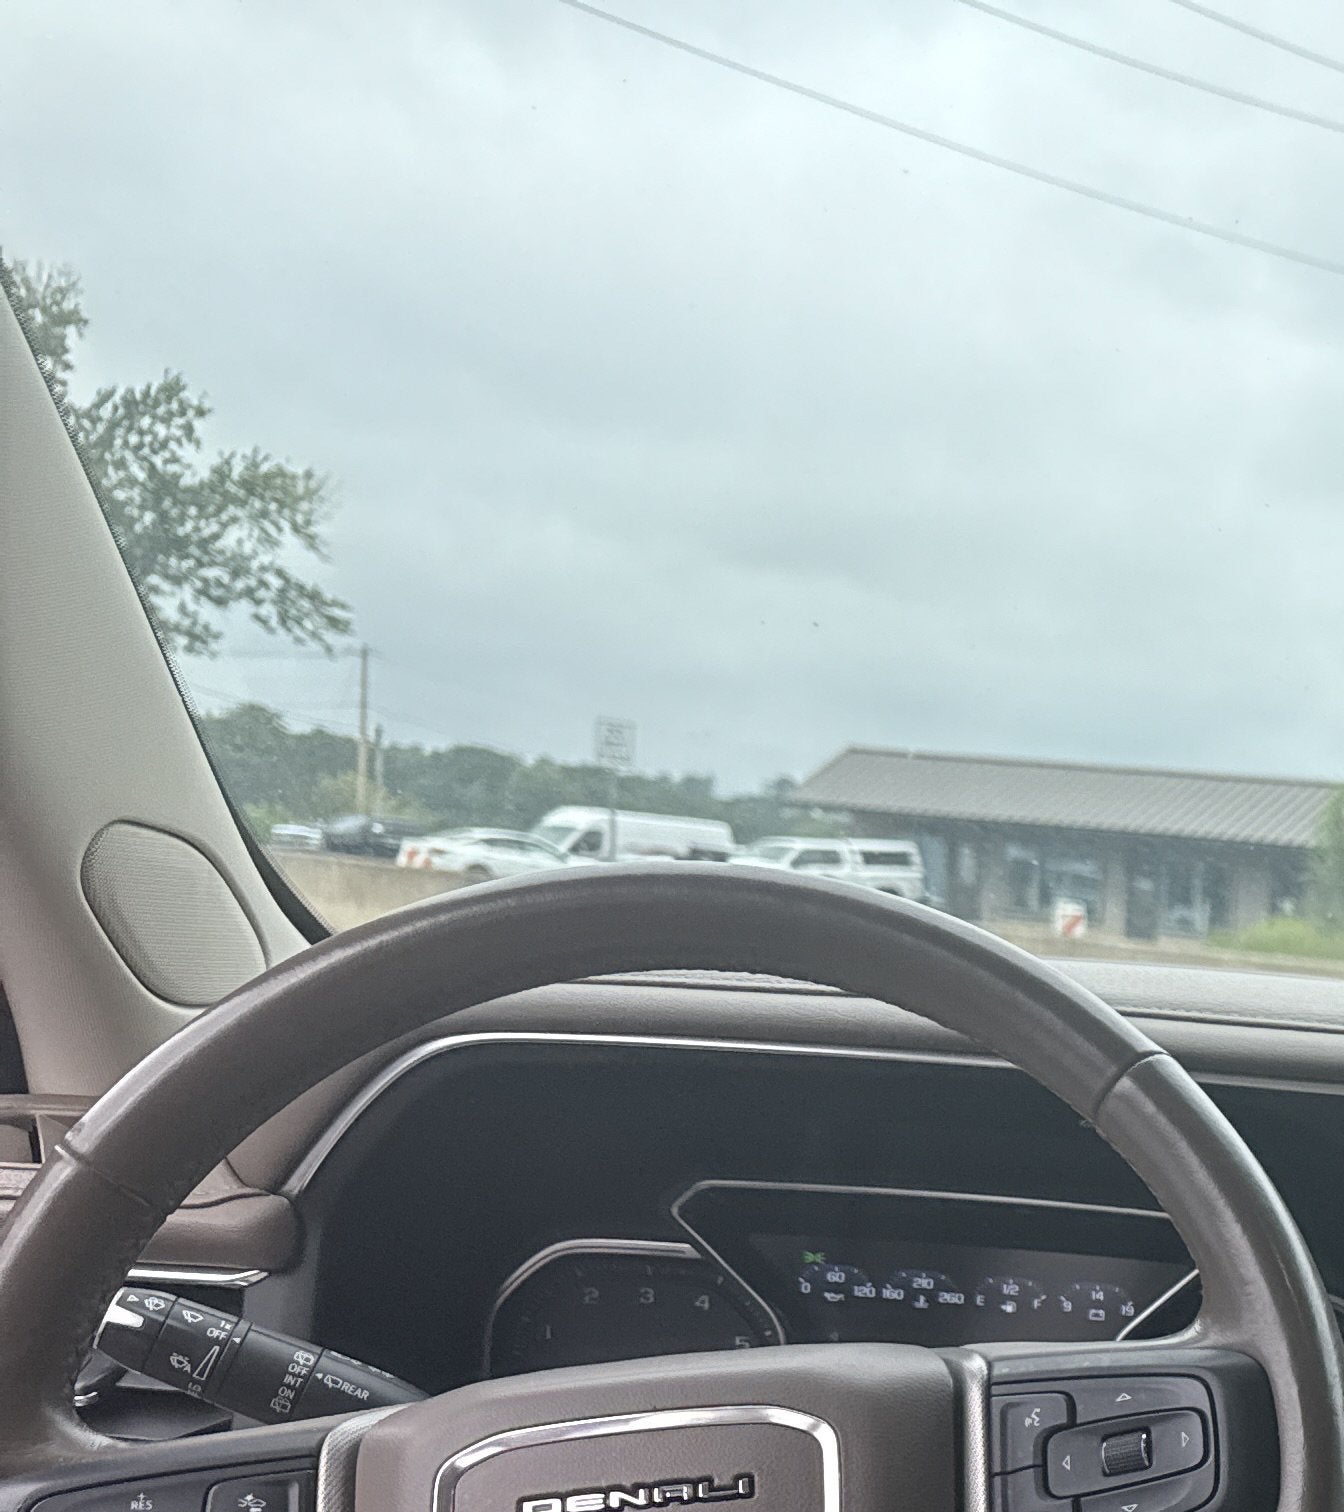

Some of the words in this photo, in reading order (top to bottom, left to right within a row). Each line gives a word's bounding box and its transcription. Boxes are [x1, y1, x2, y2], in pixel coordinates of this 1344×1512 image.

[826, 1270, 845, 1283] 60
[911, 1276, 934, 1290] 210
[800, 1281, 811, 1294] 0
[853, 1284, 876, 1299] 120
[882, 1287, 904, 1301] 160
[1001, 1284, 1020, 1296] 1/2
[640, 1287, 655, 1304] 3
[694, 1294, 710, 1310] 4
[938, 1291, 965, 1306] 260
[976, 1295, 985, 1307] E
[1090, 1289, 1104, 1301] 14
[1032, 1299, 1042, 1310] F
[1062, 1300, 1072, 1313] 9
[1120, 1303, 1135, 1317] 19
[206, 1327, 228, 1341] OFF
[734, 1335, 751, 1350] 5
[288, 1363, 310, 1376] OFF
[283, 1374, 304, 1388] INT
[278, 1386, 296, 1399] ON
[341, 1381, 371, 1401] REAR
[130, 1500, 153, 1511] RES
